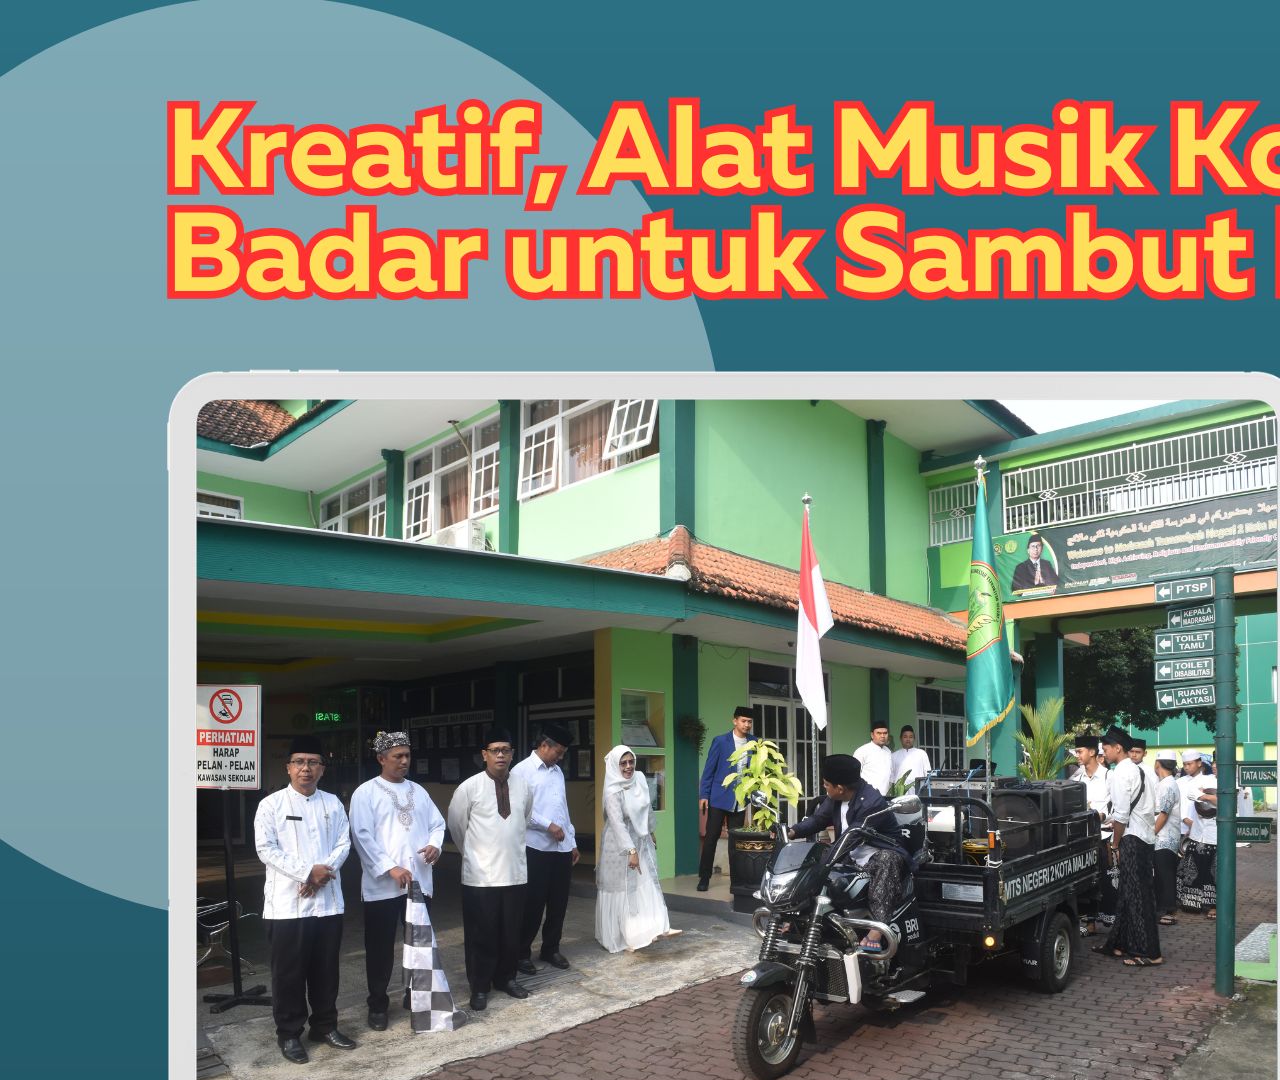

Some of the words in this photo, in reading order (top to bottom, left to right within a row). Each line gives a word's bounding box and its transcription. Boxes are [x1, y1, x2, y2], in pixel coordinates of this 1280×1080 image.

[1176, 582, 1208, 595] PTSP
[1183, 607, 1212, 618] KEPALA
[1175, 633, 1209, 643] TOILET
[1179, 641, 1205, 650] TAMU
[1175, 660, 1209, 669] TOILET
[1174, 669, 1210, 678] DISABILITAS
[1178, 688, 1208, 697] RUANG
[1176, 696, 1213, 706] LAKTASI
[199, 731, 253, 743] PERHATIAN
[213, 747, 240, 758] HARAP
[197, 760, 222, 770] PELAN
[229, 760, 255, 771] PELAN
[197, 774, 226, 782] KAWASAN
[228, 774, 256, 782] SEKOLAH
[1242, 771, 1258, 780] TATA
[1236, 827, 1260, 836] MASJID
[1004, 877, 1022, 900] MTS
[1022, 866, 1050, 894] NEGERI
[1054, 859, 1073, 879] KOTA
[1072, 849, 1098, 873] MALANG
[905, 917, 919, 934] BRI
